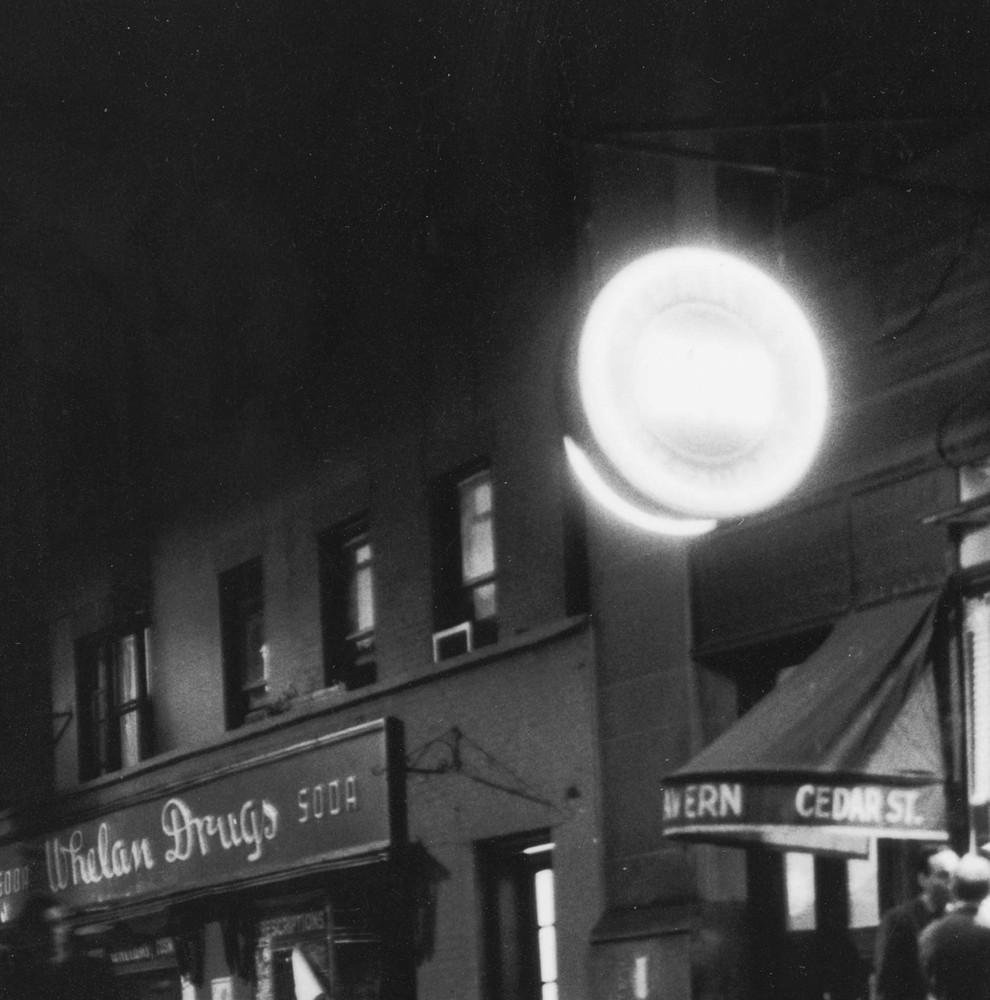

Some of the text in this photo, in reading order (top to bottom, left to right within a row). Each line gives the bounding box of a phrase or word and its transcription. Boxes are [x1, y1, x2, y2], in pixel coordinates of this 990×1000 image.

[45, 775, 357, 894] Whelan Drugs SODA
[795, 783, 883, 822] CEDAR
